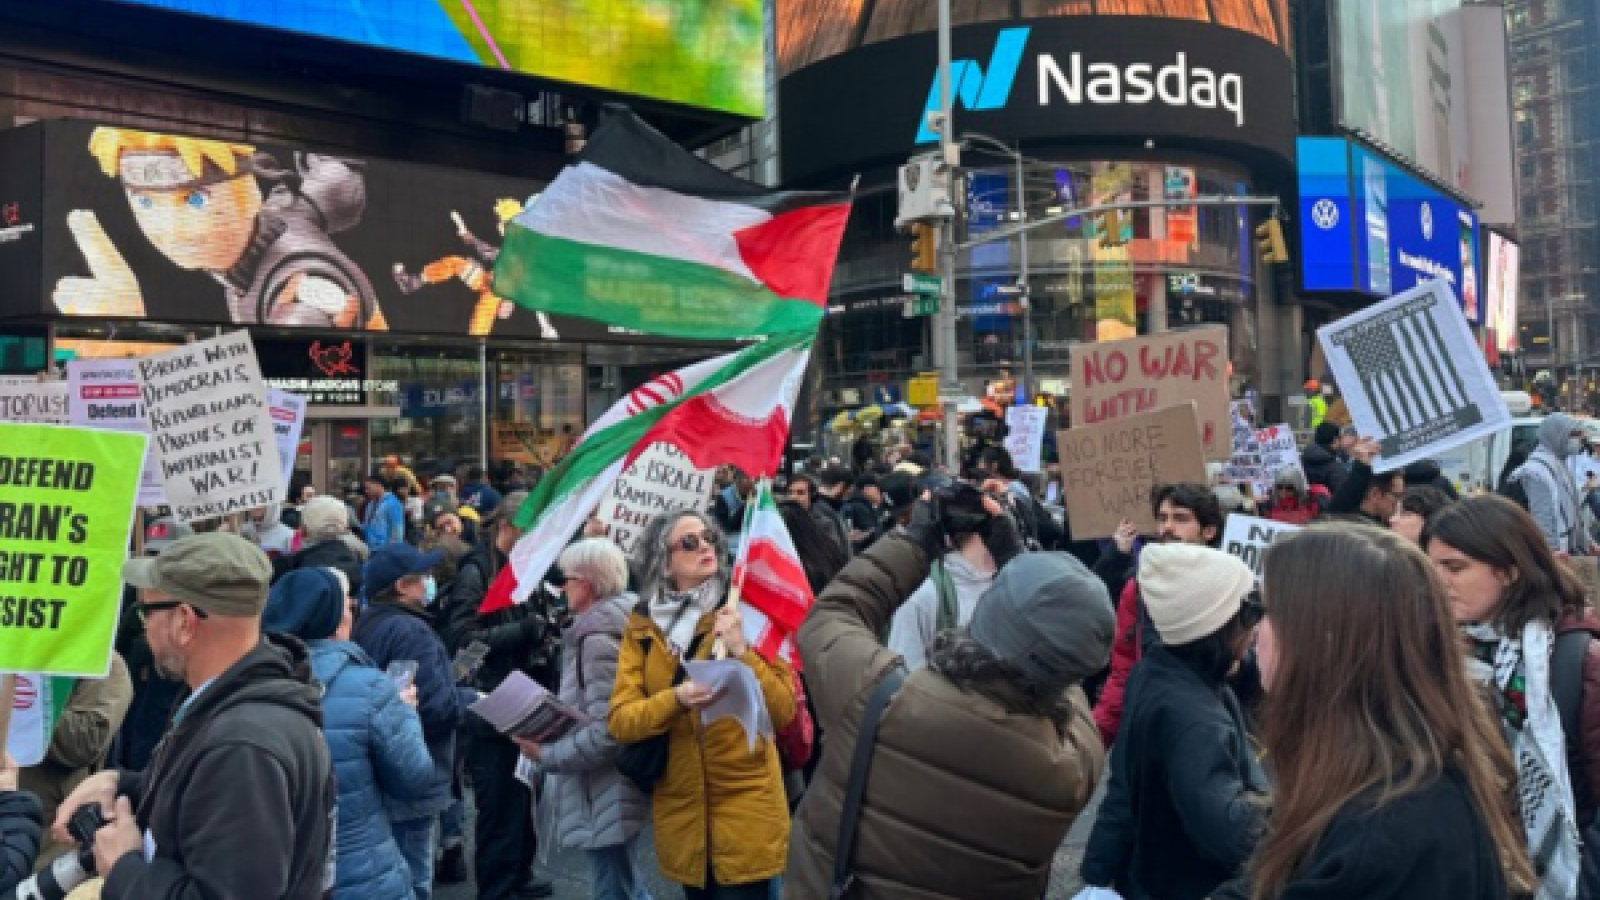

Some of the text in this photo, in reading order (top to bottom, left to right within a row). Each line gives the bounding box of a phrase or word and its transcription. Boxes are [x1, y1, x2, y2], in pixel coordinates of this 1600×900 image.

[1036, 51, 1245, 127] Nasdaq
[139, 353, 198, 381] BREAK
[1082, 340, 1219, 388] NO WAR
[0, 395, 35, 417] TOP
[88, 403, 136, 418] Defend
[1085, 388, 1158, 424] WITH
[232, 414, 257, 437] OF
[1066, 435, 1096, 463] NO
[1103, 424, 1168, 455] MORE
[0, 456, 95, 492] DEFEND
[0, 503, 89, 544] RAN's
[51, 555, 89, 586] TO
[0, 596, 67, 630] SIST
